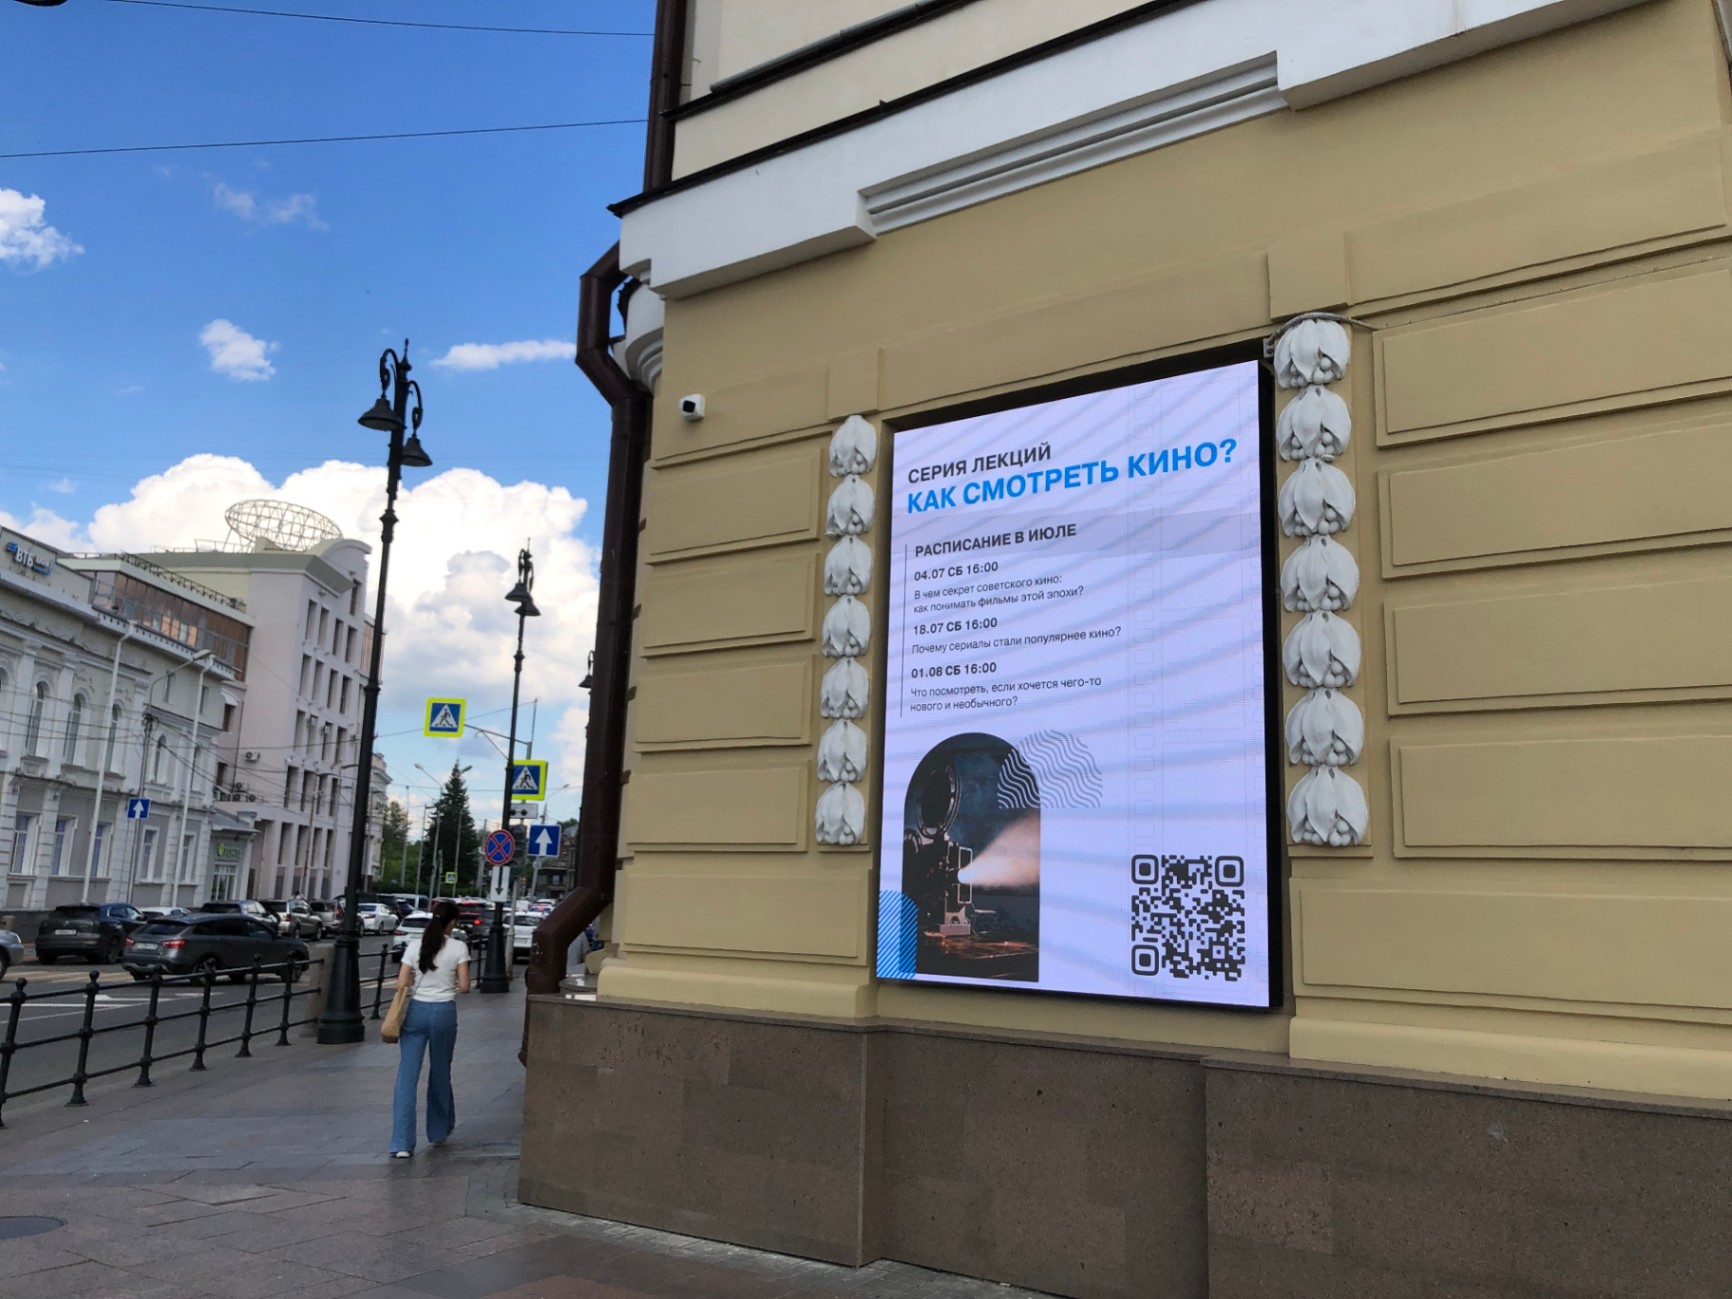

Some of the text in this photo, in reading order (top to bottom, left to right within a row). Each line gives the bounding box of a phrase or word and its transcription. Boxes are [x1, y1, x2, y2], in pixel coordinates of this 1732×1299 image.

[908, 442, 1051, 484] СЕРИЯ ЛЕКЦИЙ
[907, 438, 1237, 514] КАК СМОТРЕТЬ КИНО?
[915, 524, 1076, 557] РАСПИСАНИЕ В ИЮЛЕ
[15, 548, 34, 568] ВТБ
[914, 562, 998, 581] 04.07 СБ 16:00
[915, 576, 1061, 600] В чем секрет советского кино:
[931, 601, 976, 611] понимать
[978, 596, 1018, 607] фильмы
[1021, 590, 1044, 601] этой
[1047, 586, 1083, 599] эпохи?
[914, 617, 997, 635] 18.07 СБ 16:00
[912, 626, 1121, 653] Почему сериалы стали популярнее кино?
[911, 662, 997, 678] 01.08 СБ 16:00
[911, 678, 1101, 697] Что посмотреть, если хочется чего-то
[911, 703, 942, 711] нового
[954, 696, 1017, 709] необычного?
